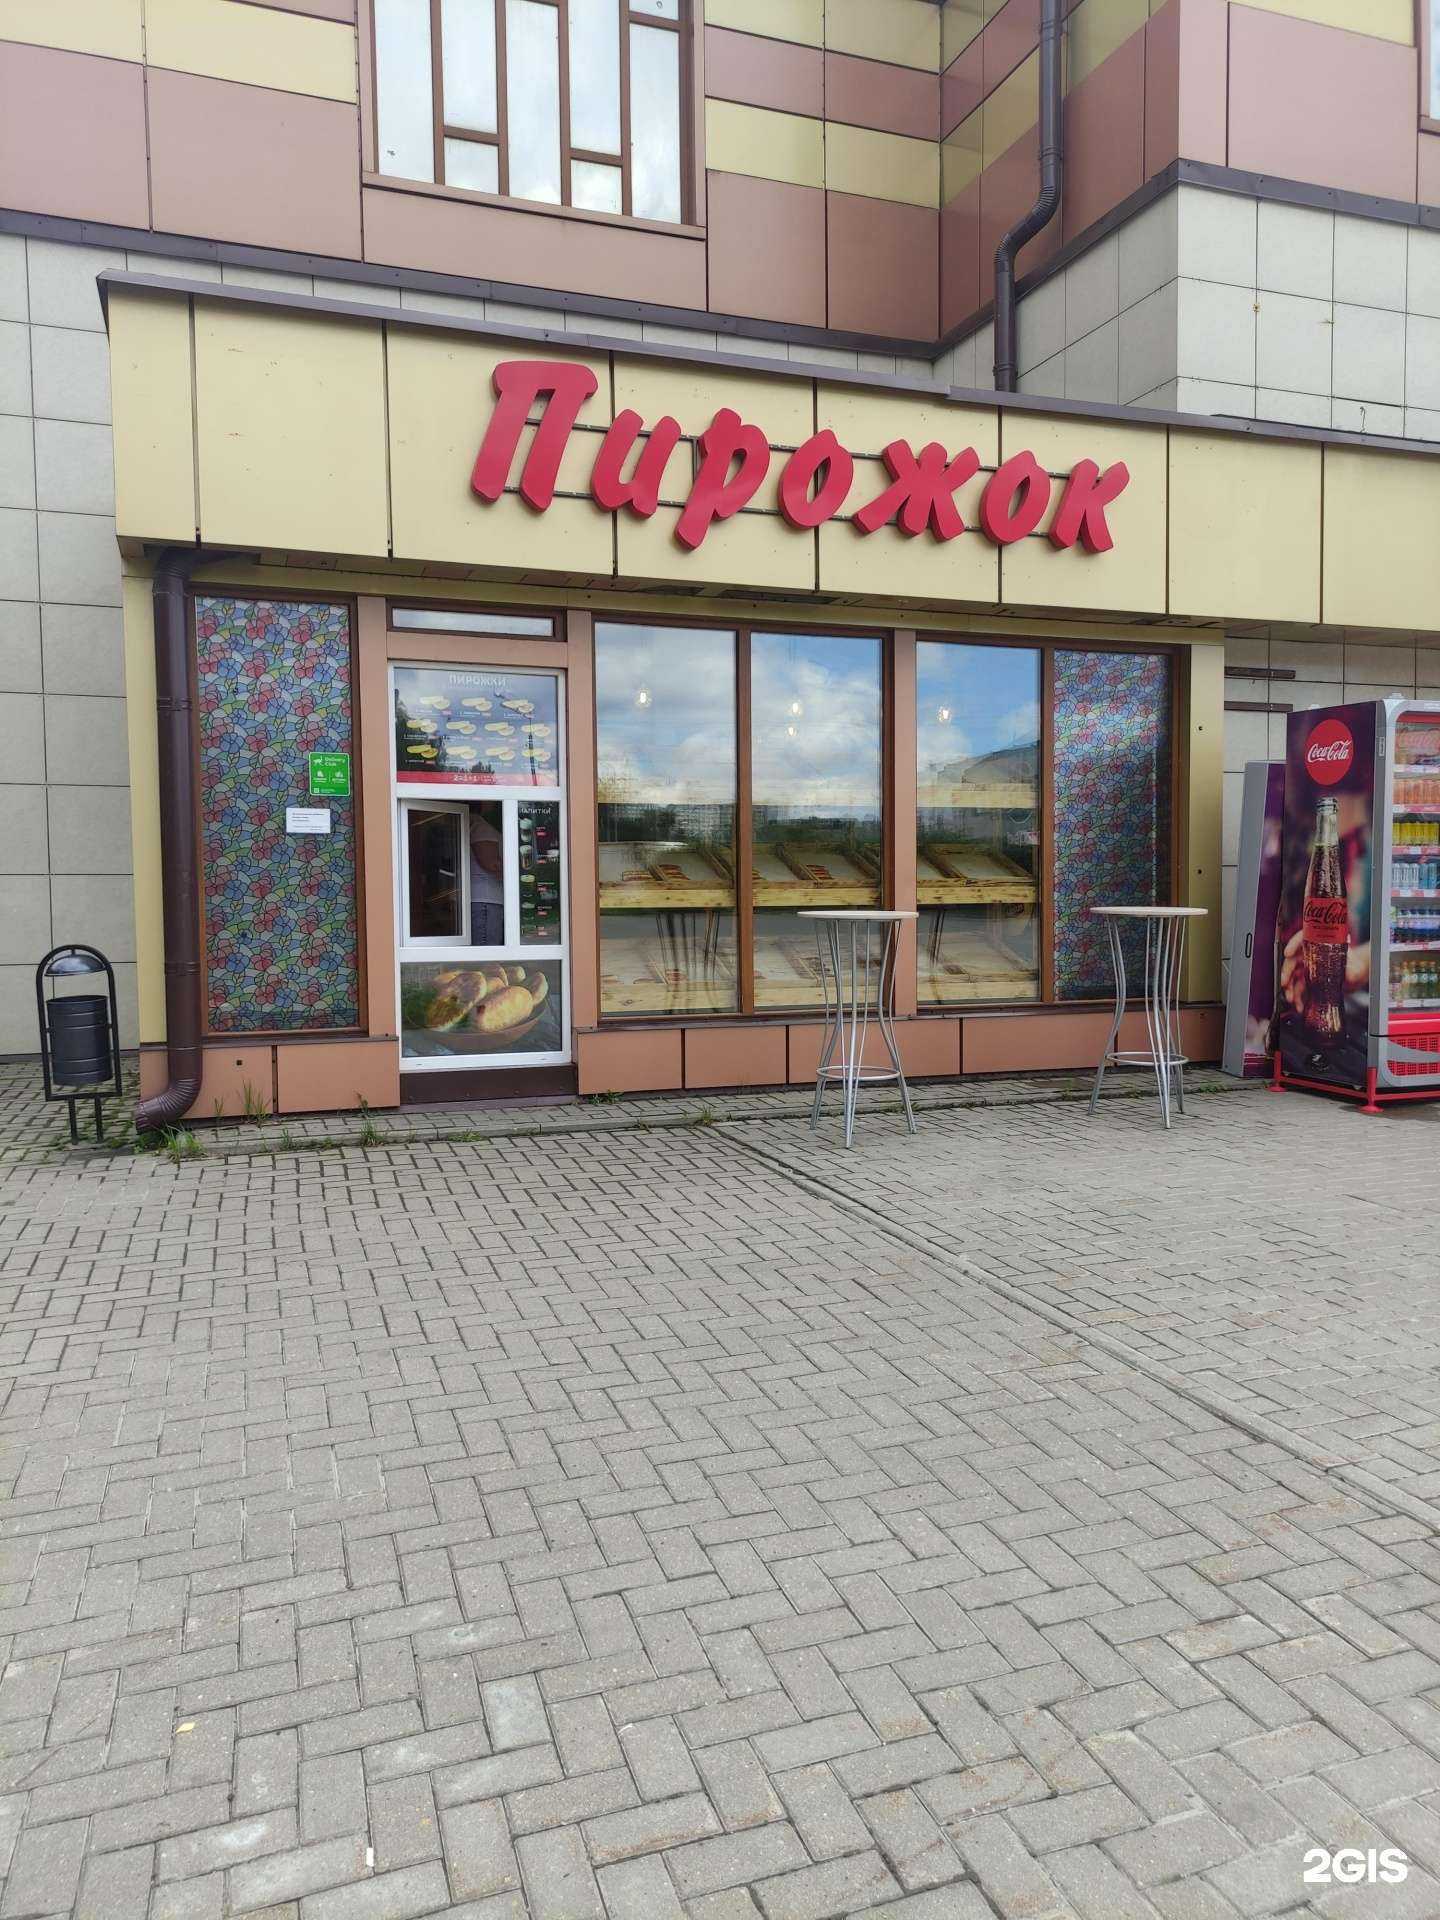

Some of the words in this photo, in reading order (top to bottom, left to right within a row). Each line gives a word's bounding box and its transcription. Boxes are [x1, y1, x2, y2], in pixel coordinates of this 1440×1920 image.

[470, 360, 1130, 554] Пирожок
[449, 673, 506, 686] ПИРОЖКИ
[1307, 740, 1352, 763] Coca-Cola
